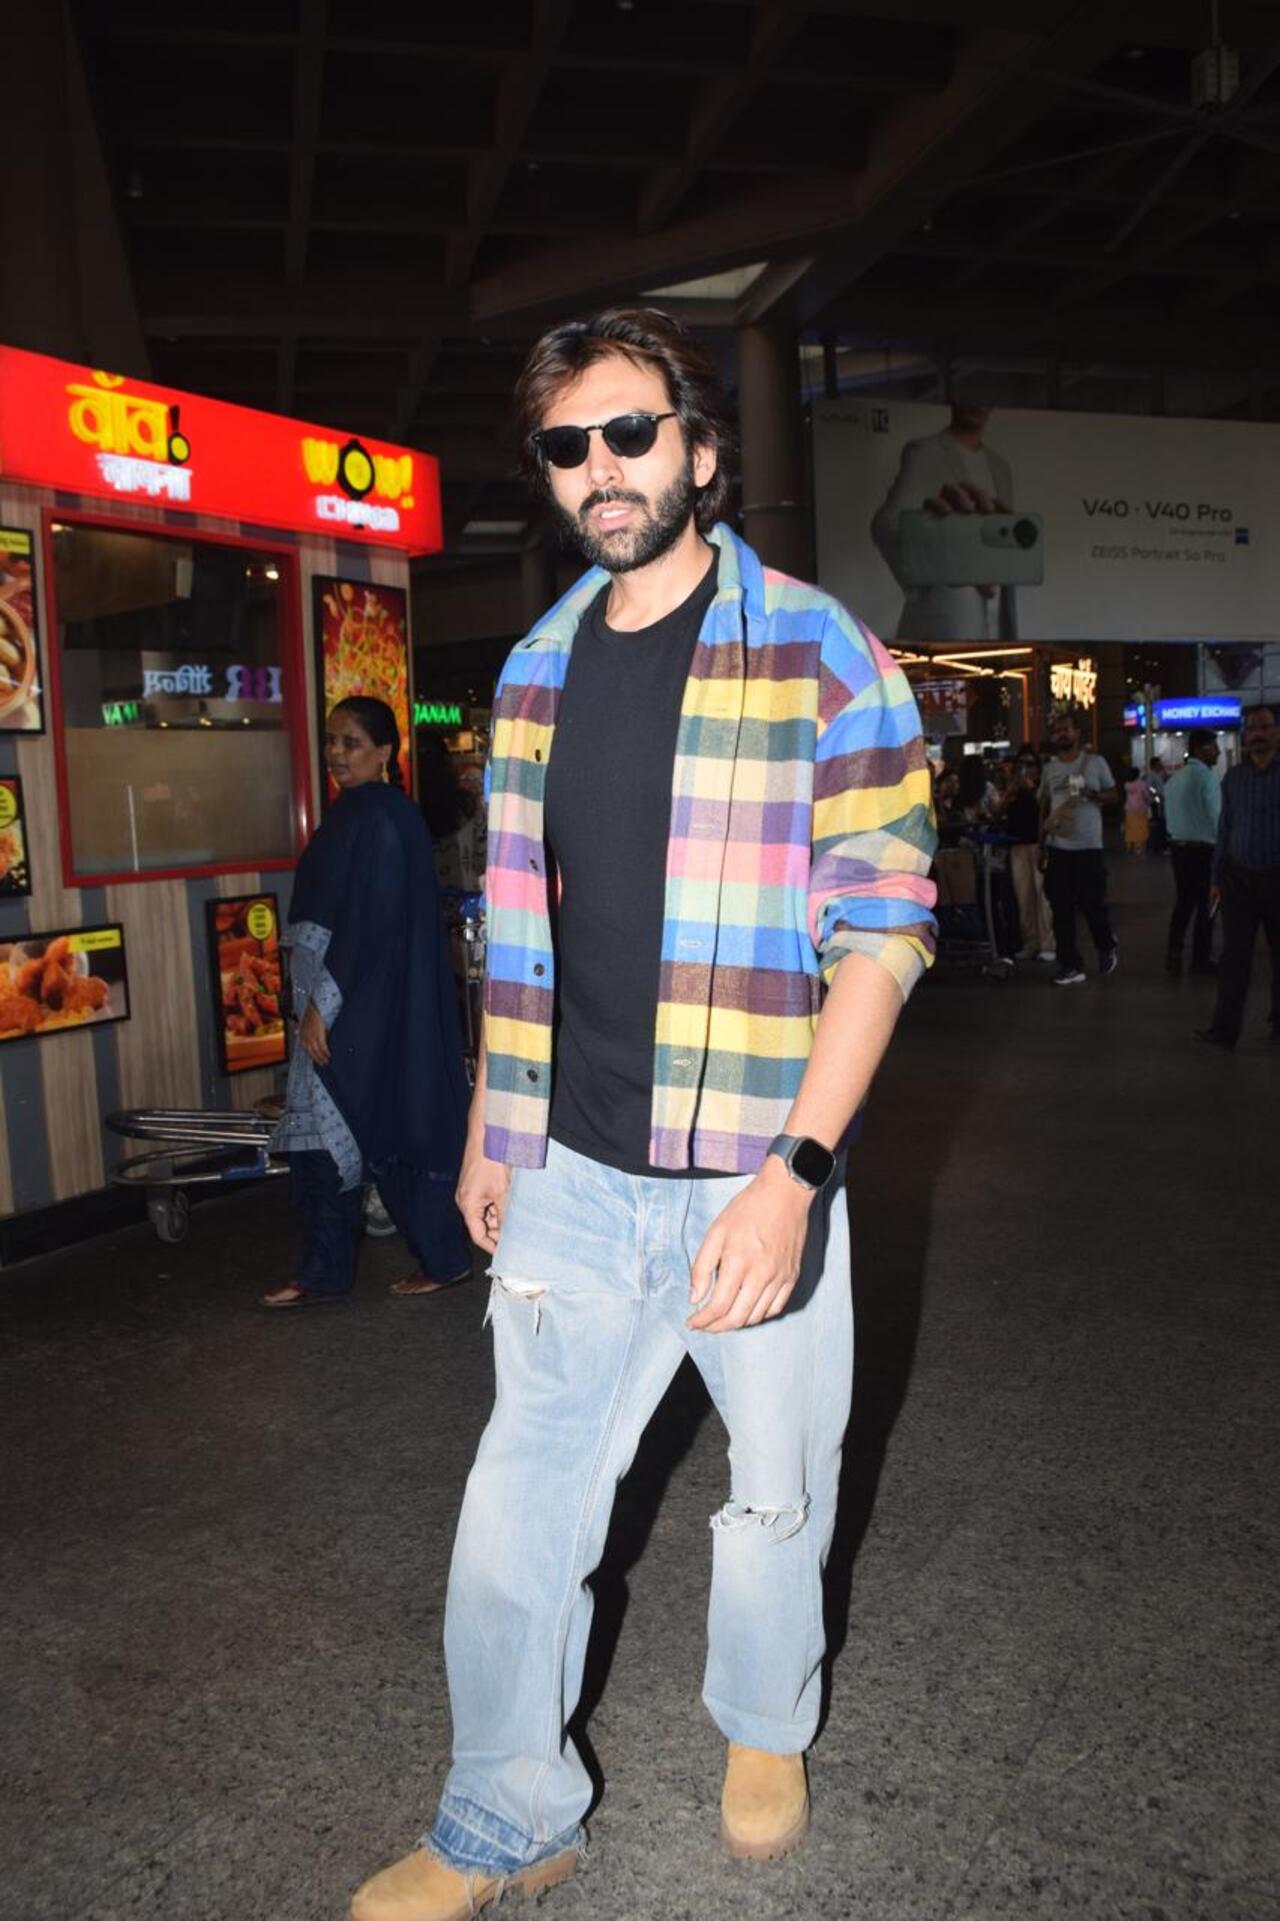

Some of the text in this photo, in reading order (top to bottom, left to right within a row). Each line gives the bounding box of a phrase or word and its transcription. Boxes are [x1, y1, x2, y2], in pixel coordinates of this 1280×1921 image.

[301, 438, 414, 509] WOW!
[1082, 498, 1233, 523] V40 V40 Pro
[1131, 546, 1179, 561] Portrait
[1204, 550, 1226, 562] Pro
[1162, 708, 1199, 720] MONEY
